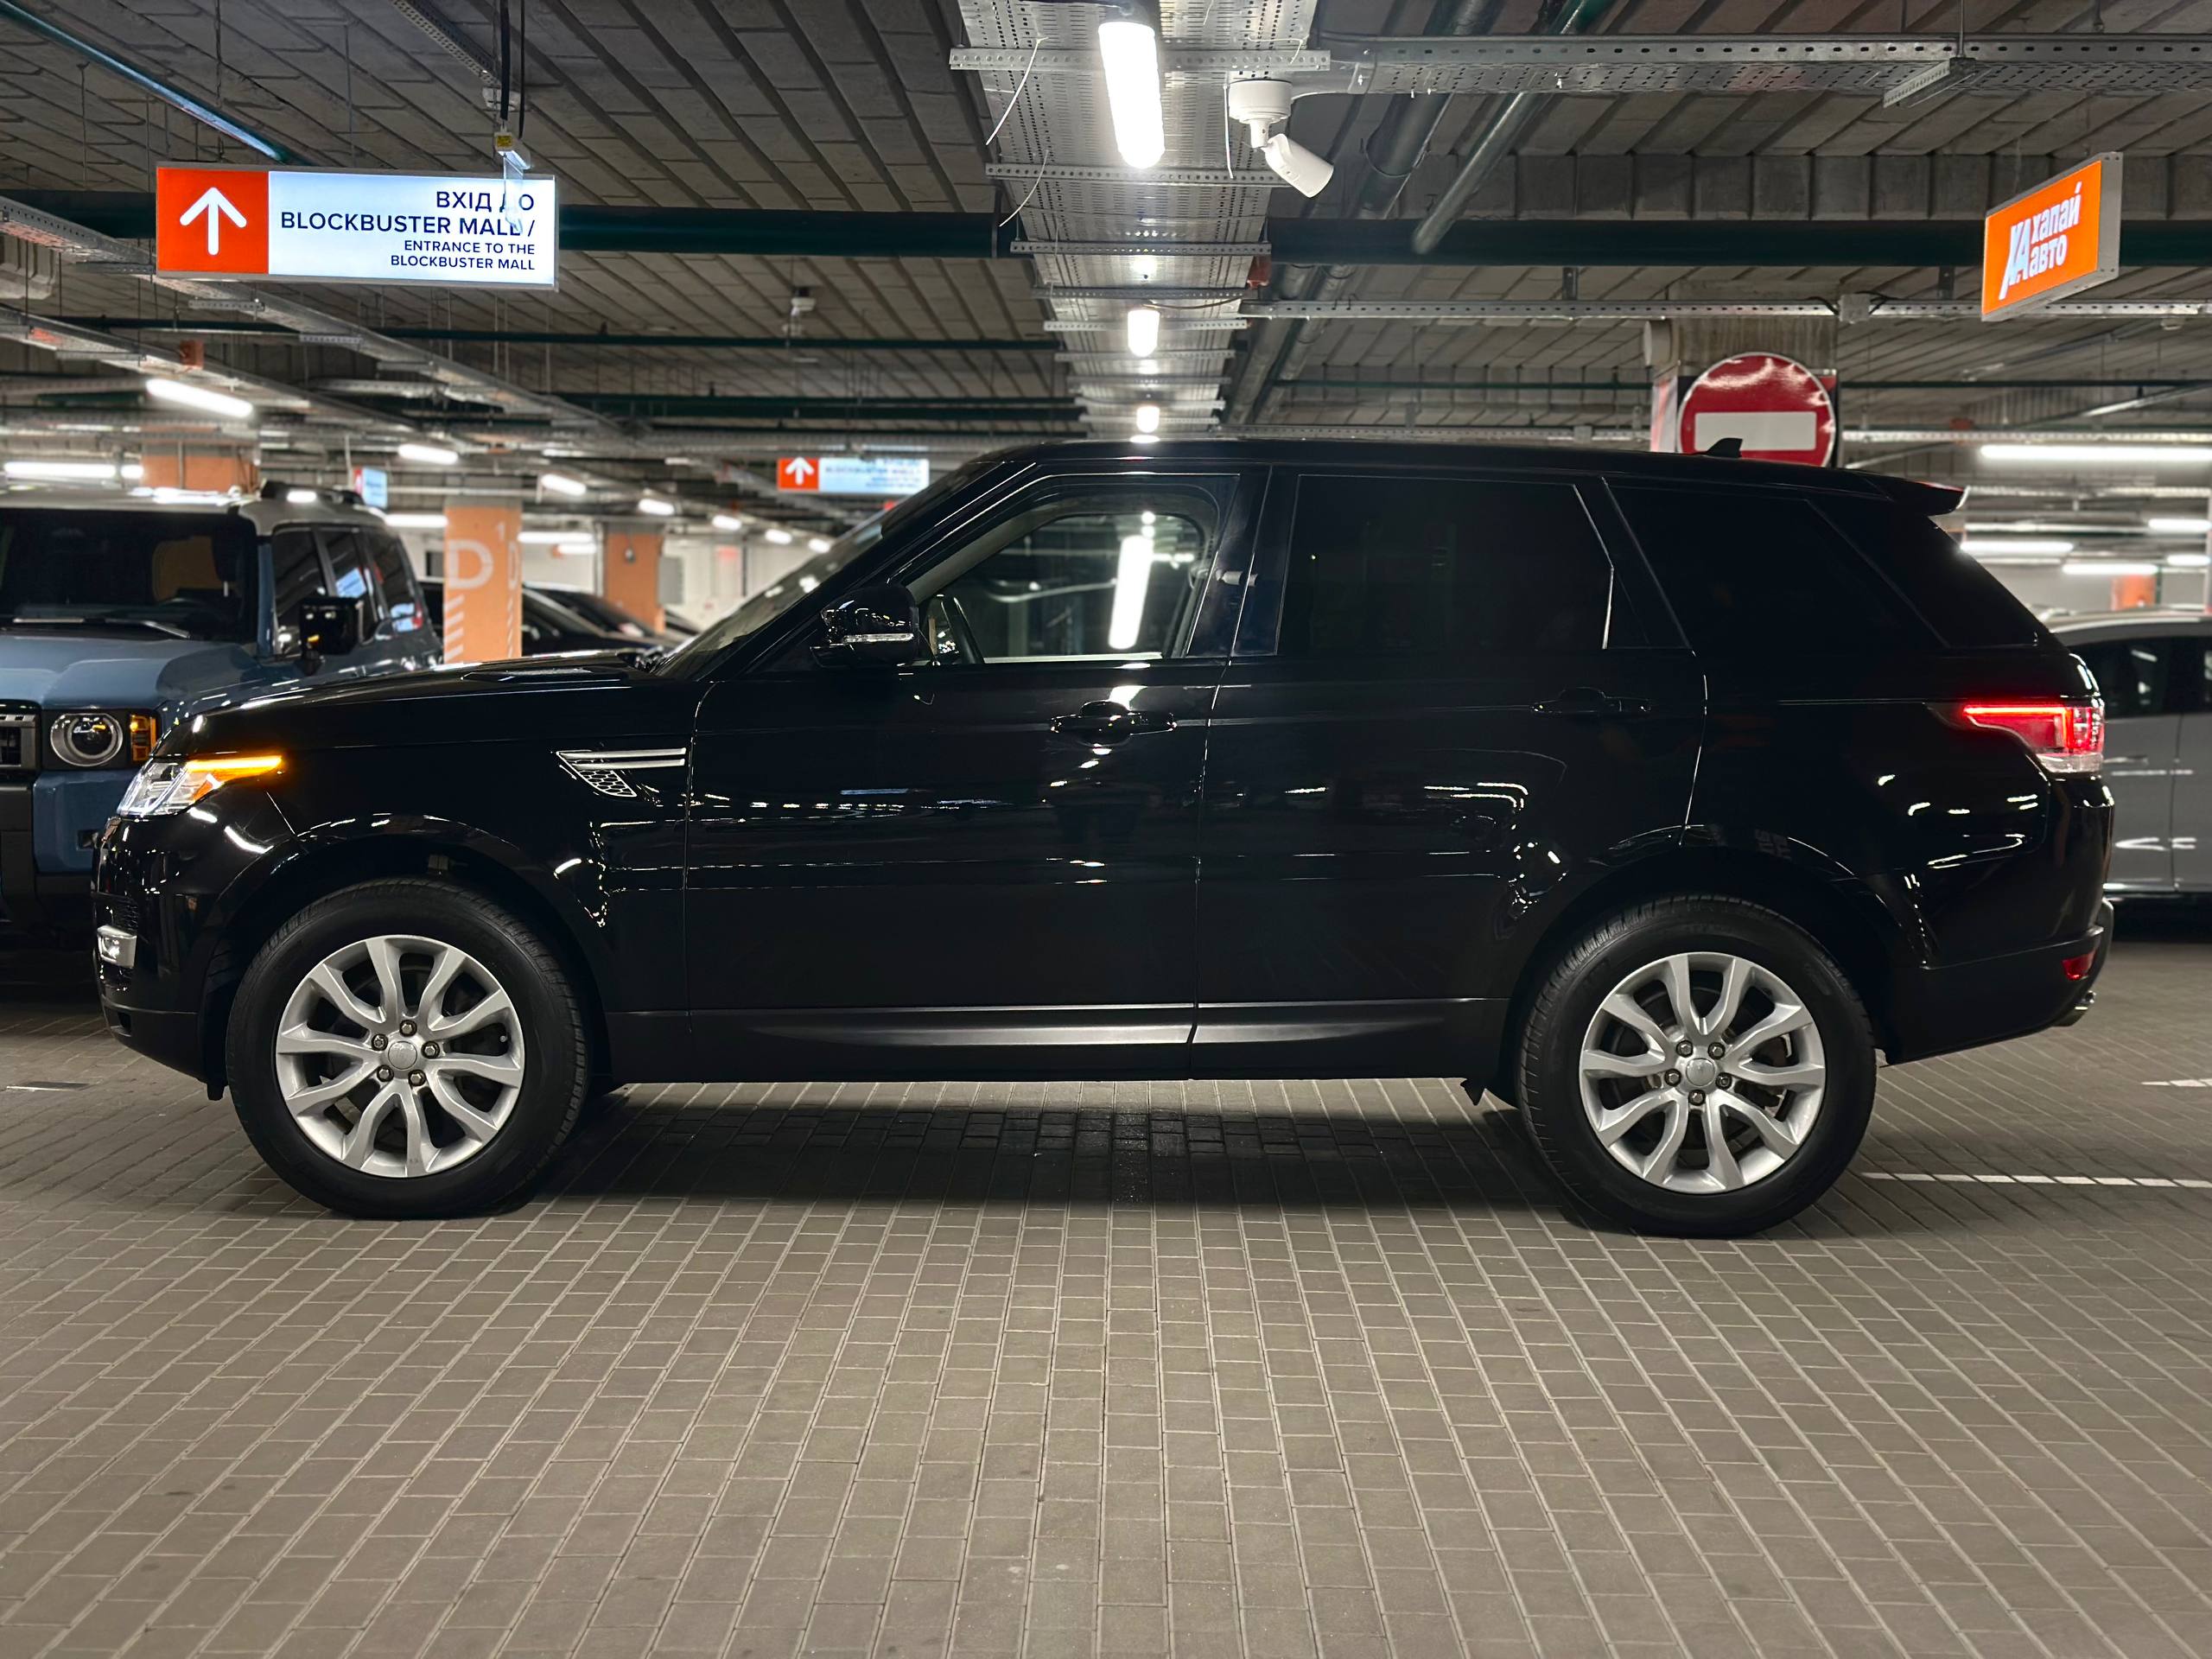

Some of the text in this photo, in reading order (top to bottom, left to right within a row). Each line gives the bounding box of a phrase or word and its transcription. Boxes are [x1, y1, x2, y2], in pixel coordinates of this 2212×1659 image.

[436, 191, 492, 212] ВХІД
[2031, 181, 2082, 245] хапай
[281, 212, 450, 233] BLOCKBUSTER
[459, 218, 521, 236] MALL
[404, 240, 535, 255] ENTRANCE TO THE
[2030, 234, 2068, 277] авто
[391, 255, 535, 270] BLOCKBUSTER MALL
[448, 538, 493, 590] D
